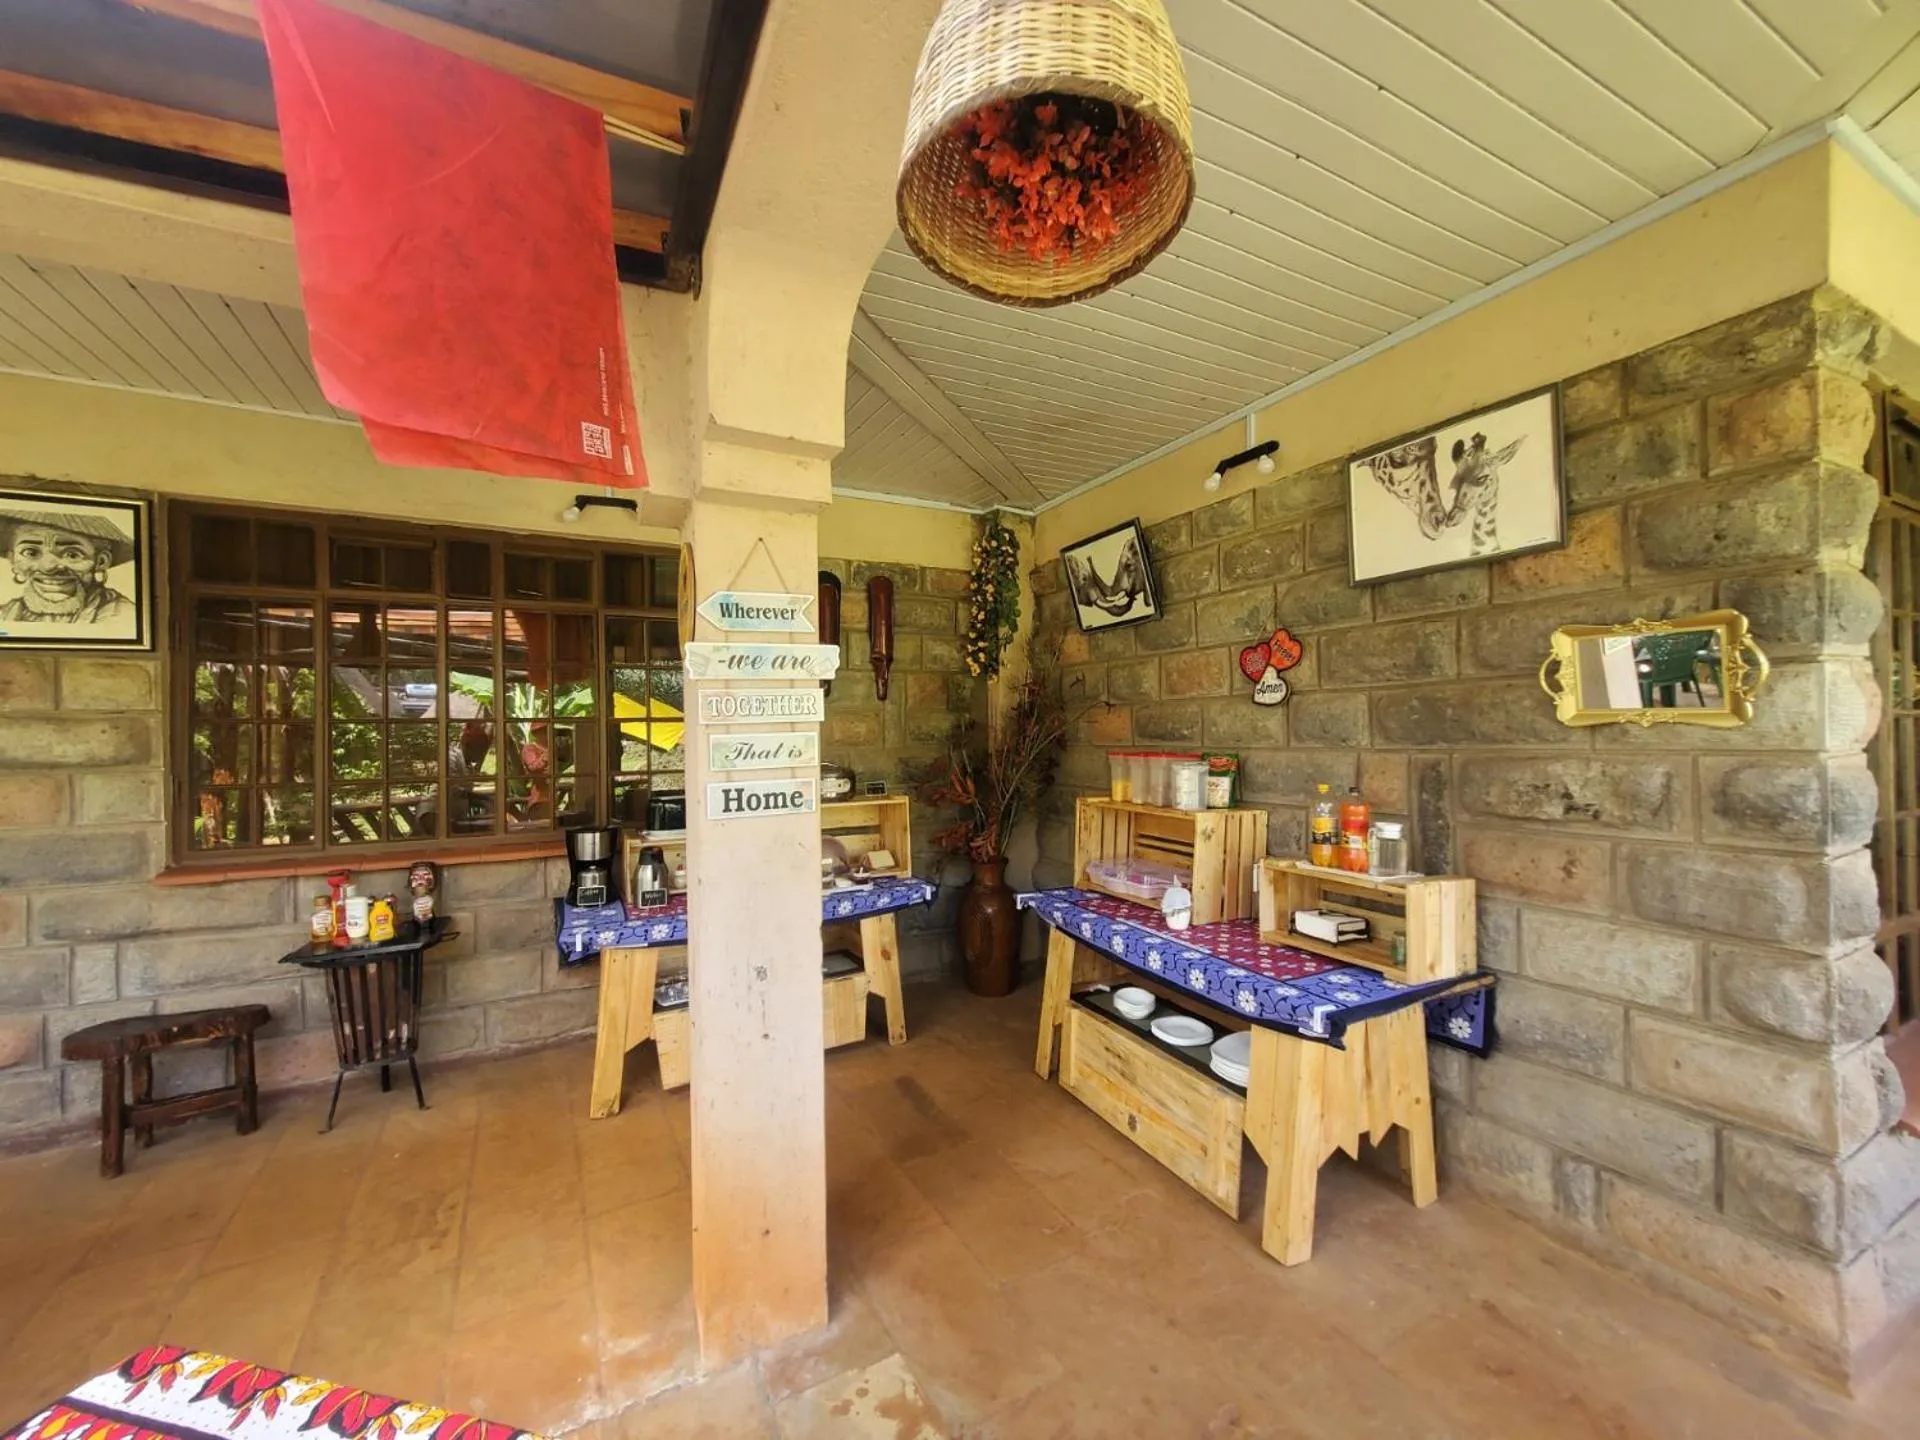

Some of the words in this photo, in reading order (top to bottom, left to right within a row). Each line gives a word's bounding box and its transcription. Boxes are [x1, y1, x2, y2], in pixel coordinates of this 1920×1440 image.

[718, 602, 797, 621] Wherever
[770, 654, 814, 671] are
[708, 695, 818, 717] TOGETHER
[725, 741, 783, 761] That
[787, 742, 803, 759] is
[721, 787, 805, 813] Home
